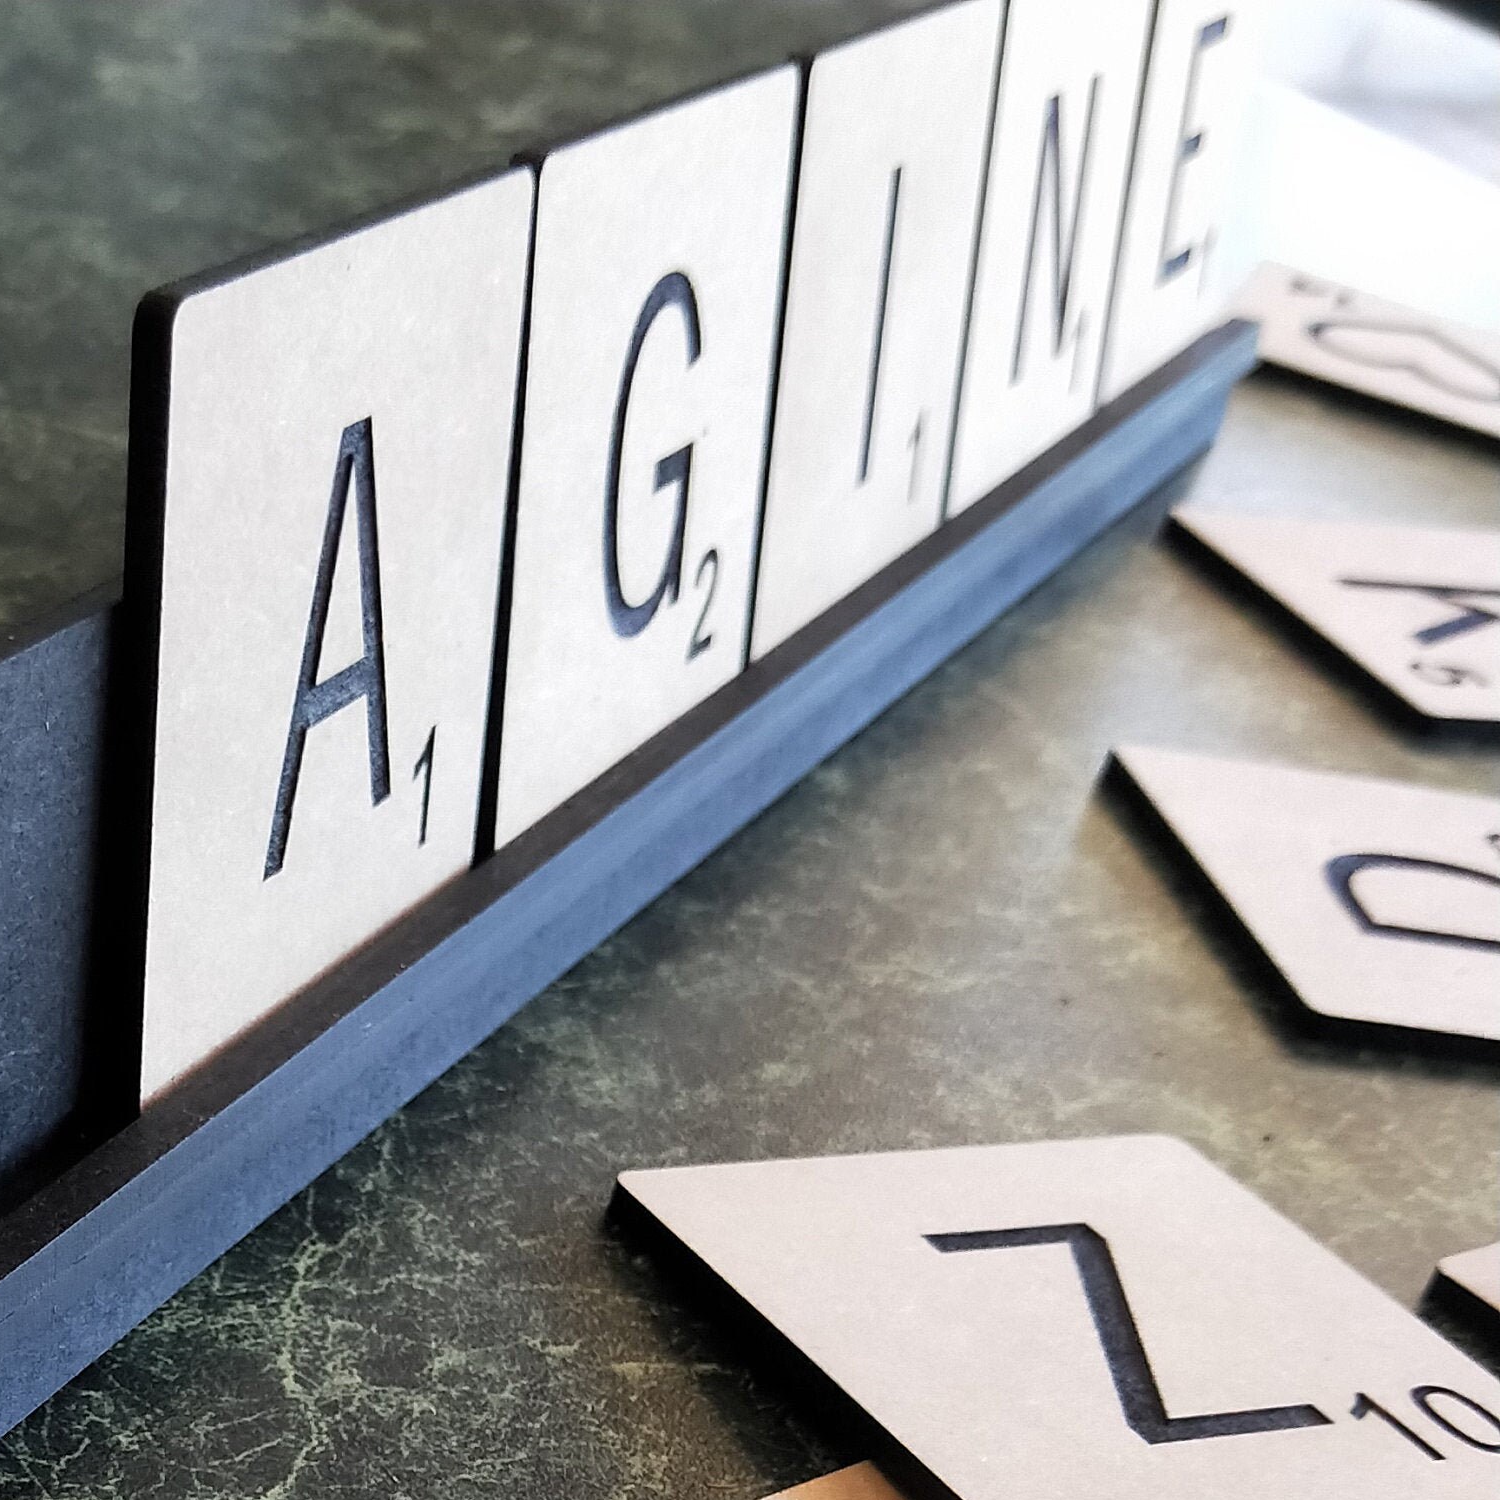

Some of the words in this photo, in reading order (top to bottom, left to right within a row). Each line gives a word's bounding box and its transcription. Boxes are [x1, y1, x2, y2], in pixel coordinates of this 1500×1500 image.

[1009, 72, 1102, 386] N
[1156, 17, 1228, 288] E
[603, 272, 701, 640] G
[686, 547, 718, 663] 2
[857, 165, 902, 486] I
[263, 415, 391, 882] A
[412, 724, 437, 849] 1
[921, 1223, 1334, 1445] Z
